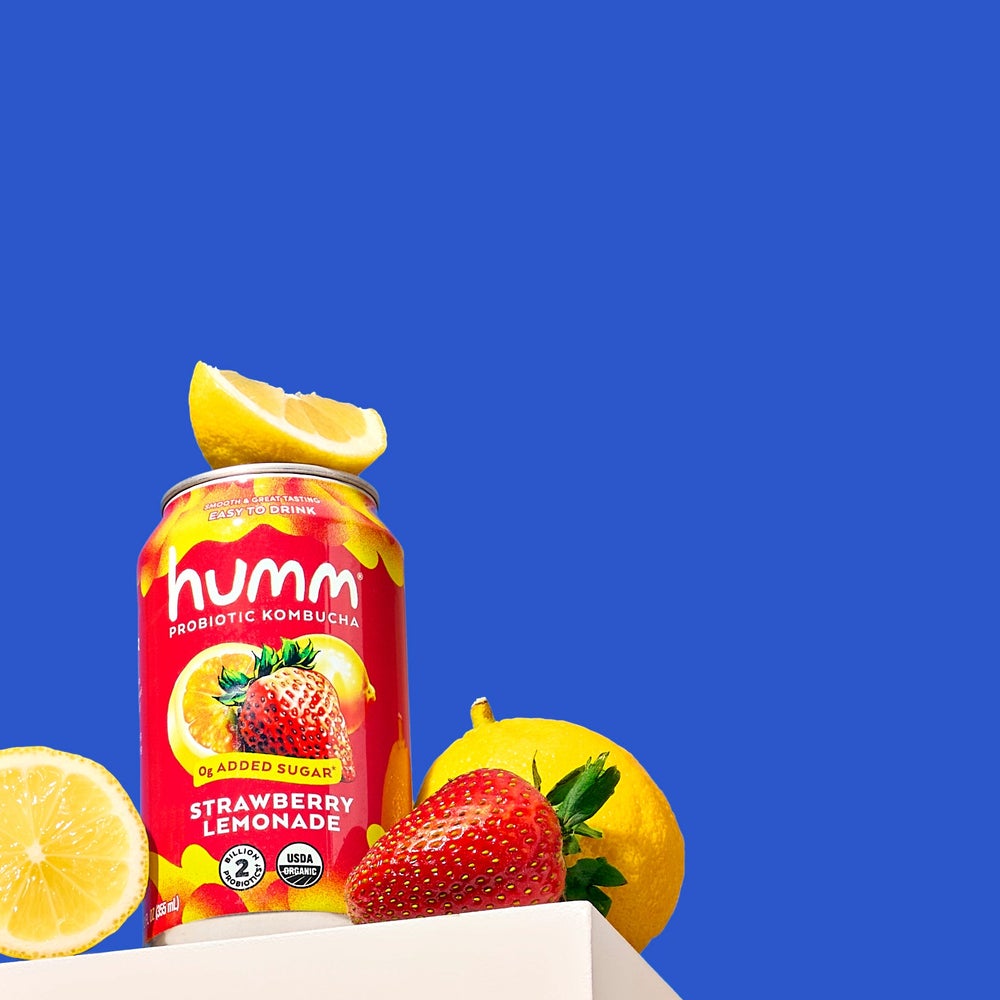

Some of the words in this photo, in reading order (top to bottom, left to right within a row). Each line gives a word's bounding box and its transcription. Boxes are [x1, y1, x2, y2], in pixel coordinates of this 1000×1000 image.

[203, 499, 241, 510] SMOOTH
[252, 495, 281, 503] GREAT
[283, 495, 320, 504] TASTING
[208, 507, 243, 521] EASY
[247, 505, 266, 515] TO
[270, 505, 316, 515] DRINK
[169, 610, 255, 638] PROBIOTIC
[262, 609, 359, 628] KOMBUCHA
[198, 765, 213, 778] 0g
[217, 760, 272, 773] ADDED
[190, 792, 354, 820] STRAWBERRY
[203, 813, 341, 837] LEMONADE
[224, 848, 259, 864] BILLION
[287, 853, 313, 863] USDA
[235, 858, 249, 877] 2
[283, 866, 317, 876] ORGANIC
